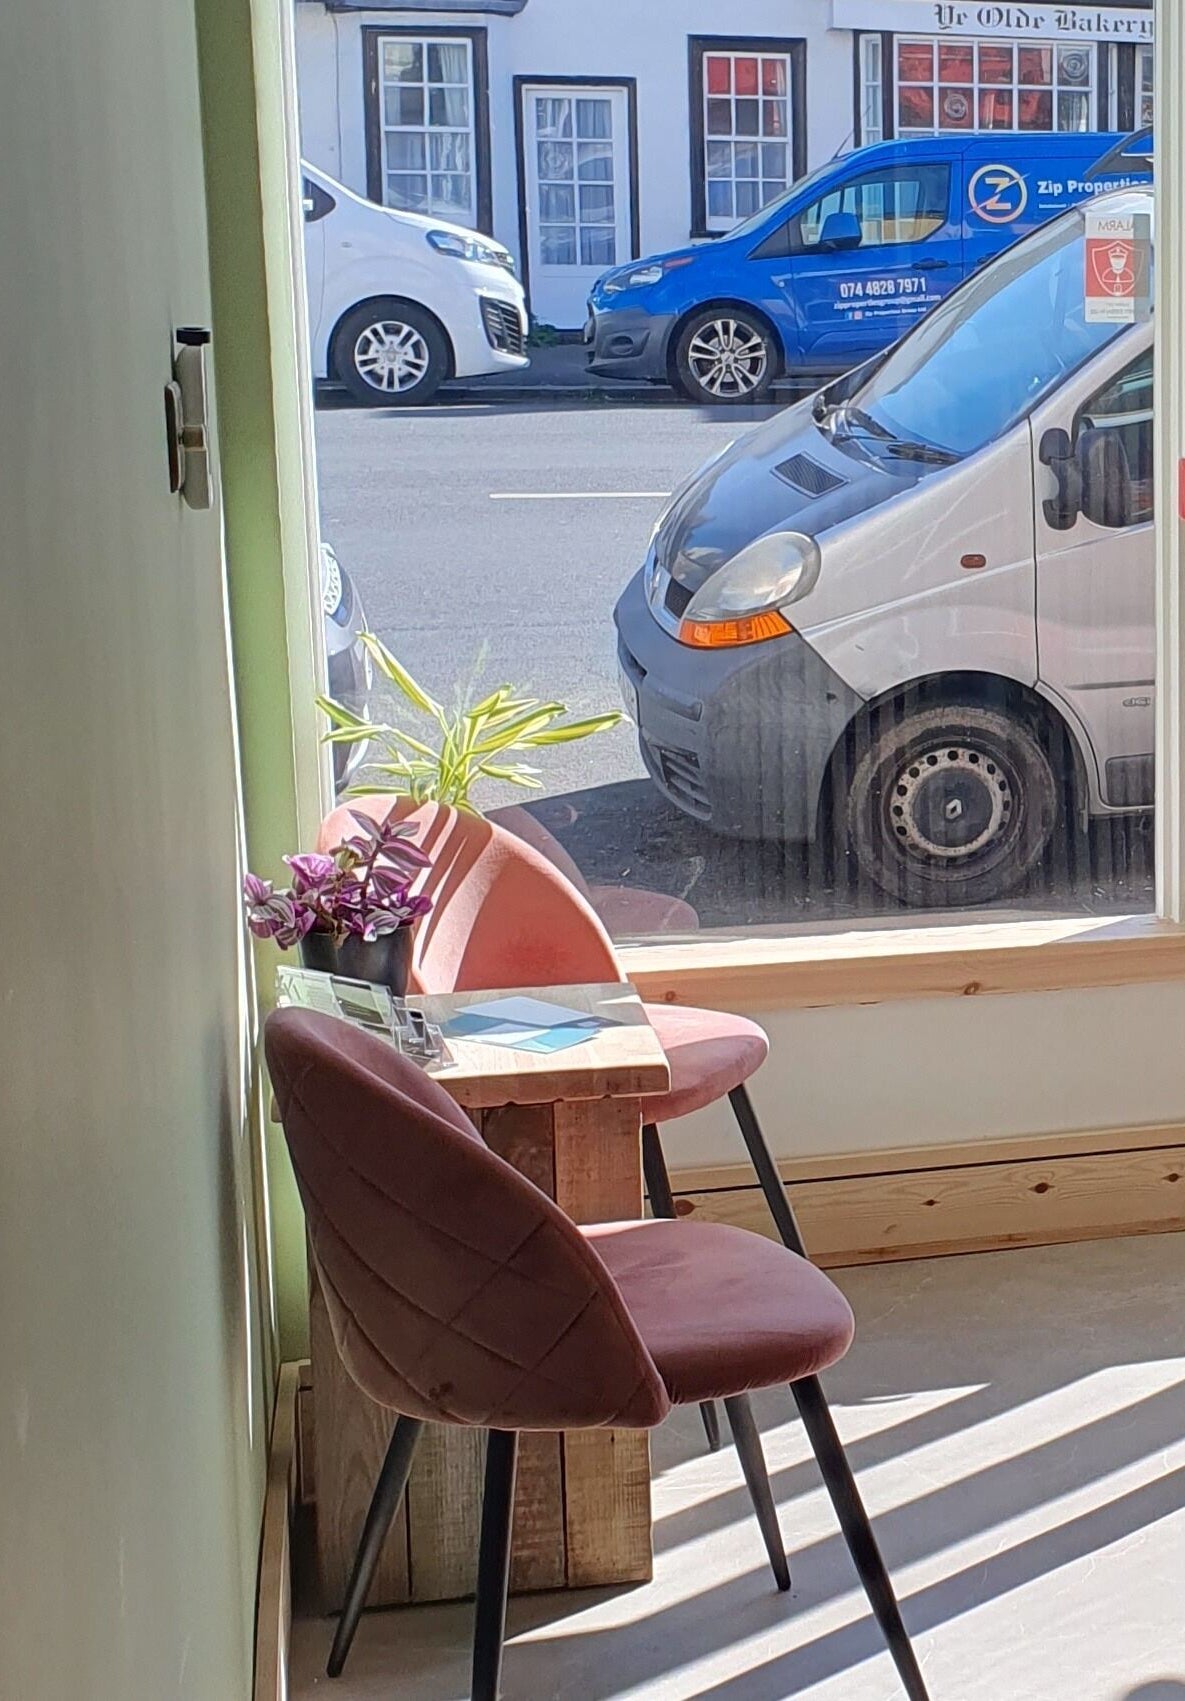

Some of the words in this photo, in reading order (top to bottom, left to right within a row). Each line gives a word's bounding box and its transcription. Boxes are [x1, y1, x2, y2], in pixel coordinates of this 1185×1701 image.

[934, 4, 968, 30] Ye
[976, 6, 1046, 29] Olde
[1054, 9, 1154, 39] Bakery
[1037, 179, 1063, 197] Zip
[840, 282, 864, 298] 074
[865, 279, 896, 296] 4828
[897, 277, 927, 294] 7971
